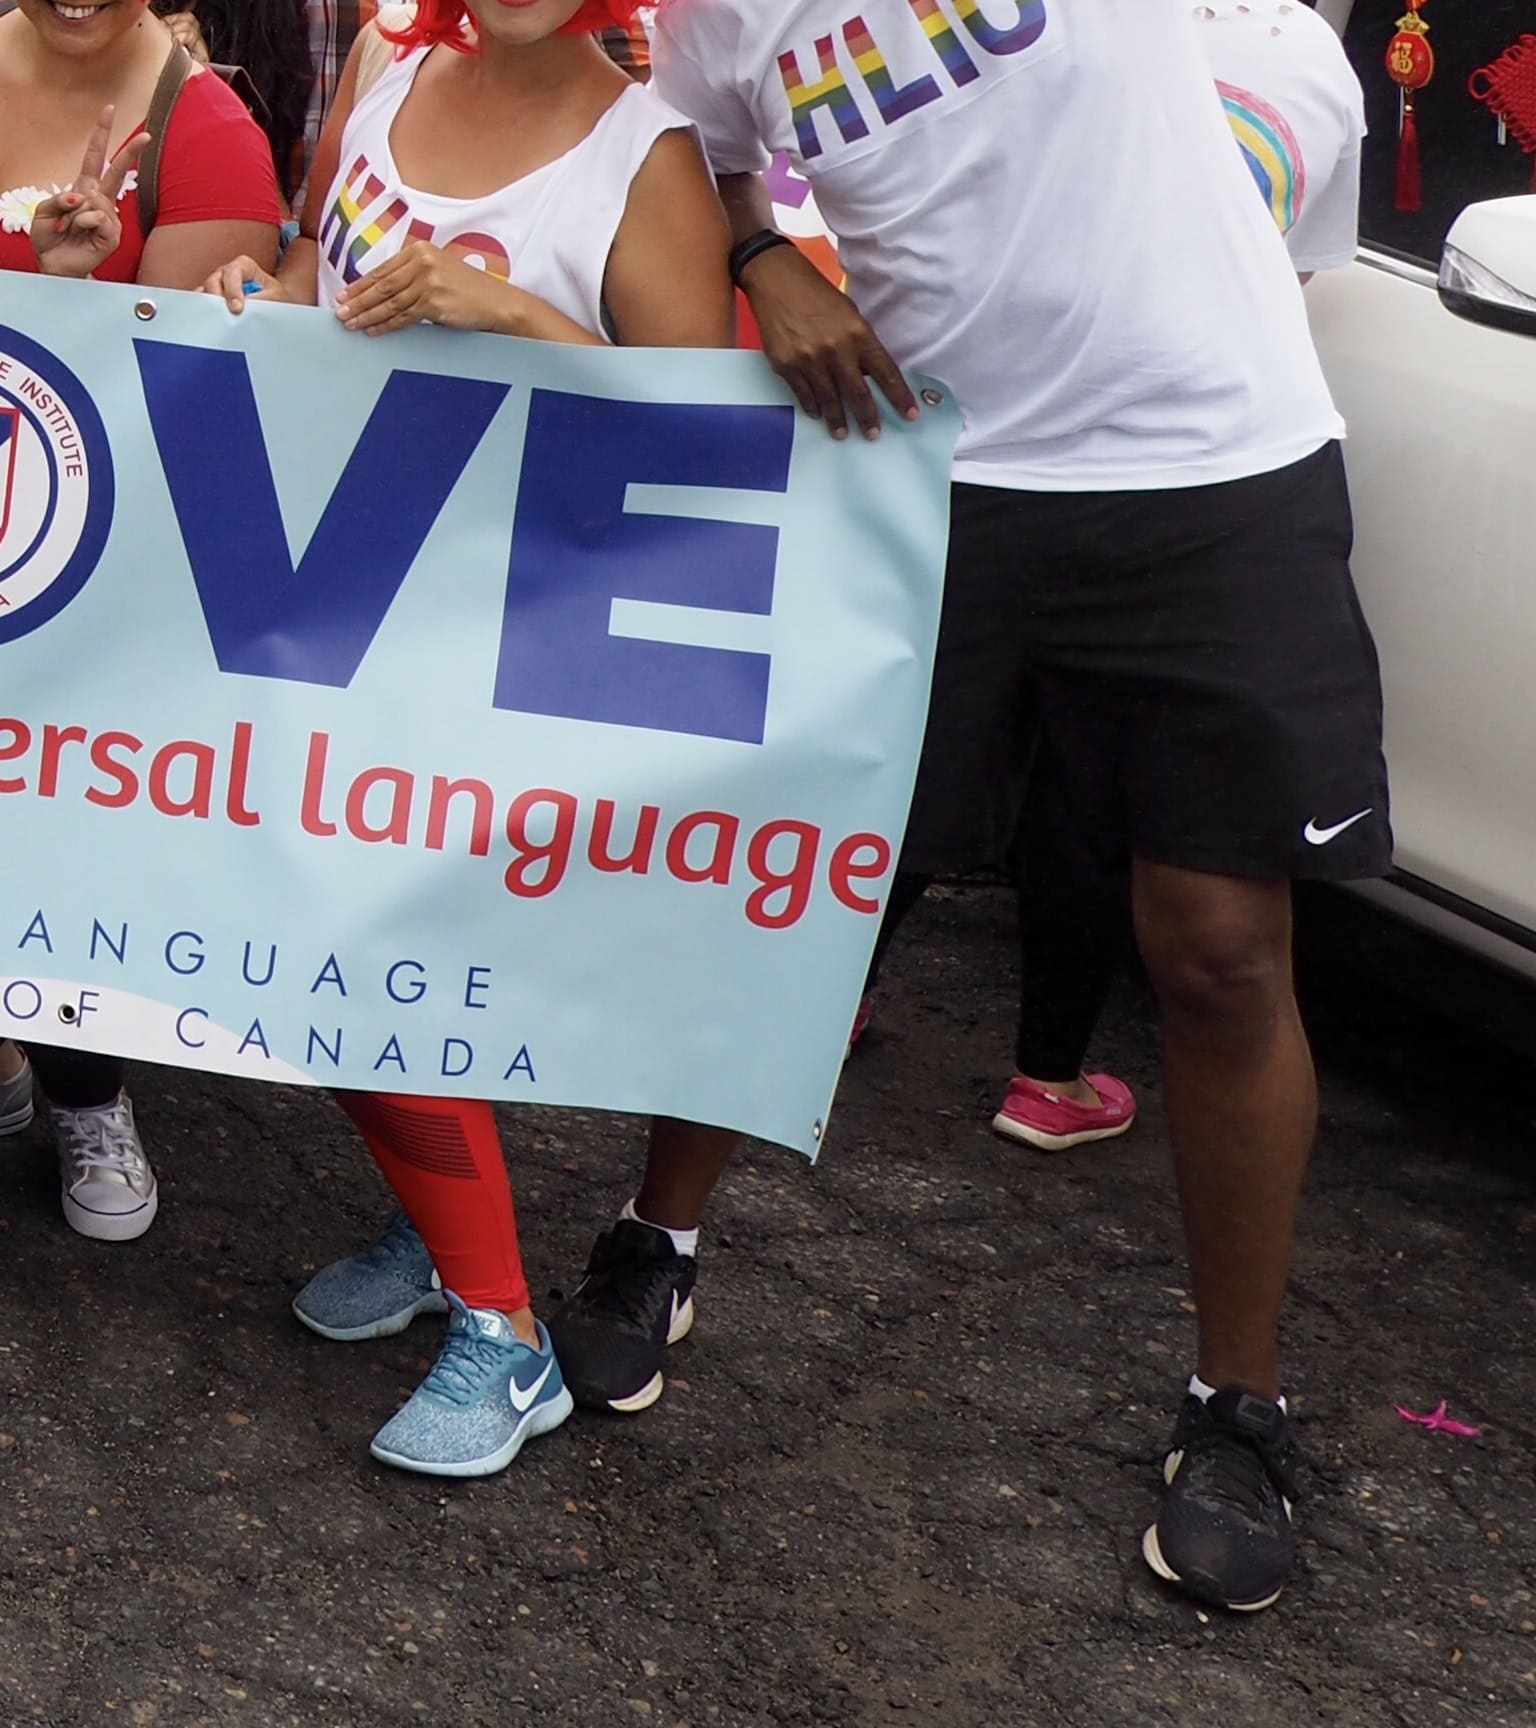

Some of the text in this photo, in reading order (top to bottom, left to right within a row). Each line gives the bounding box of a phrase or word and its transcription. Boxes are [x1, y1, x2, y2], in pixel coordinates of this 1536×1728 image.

[18, 376, 84, 478] INSTITUTE
[299, 731, 891, 930] language
[3, 979, 101, 1029] OF
[175, 1007, 537, 1083] CANADA
